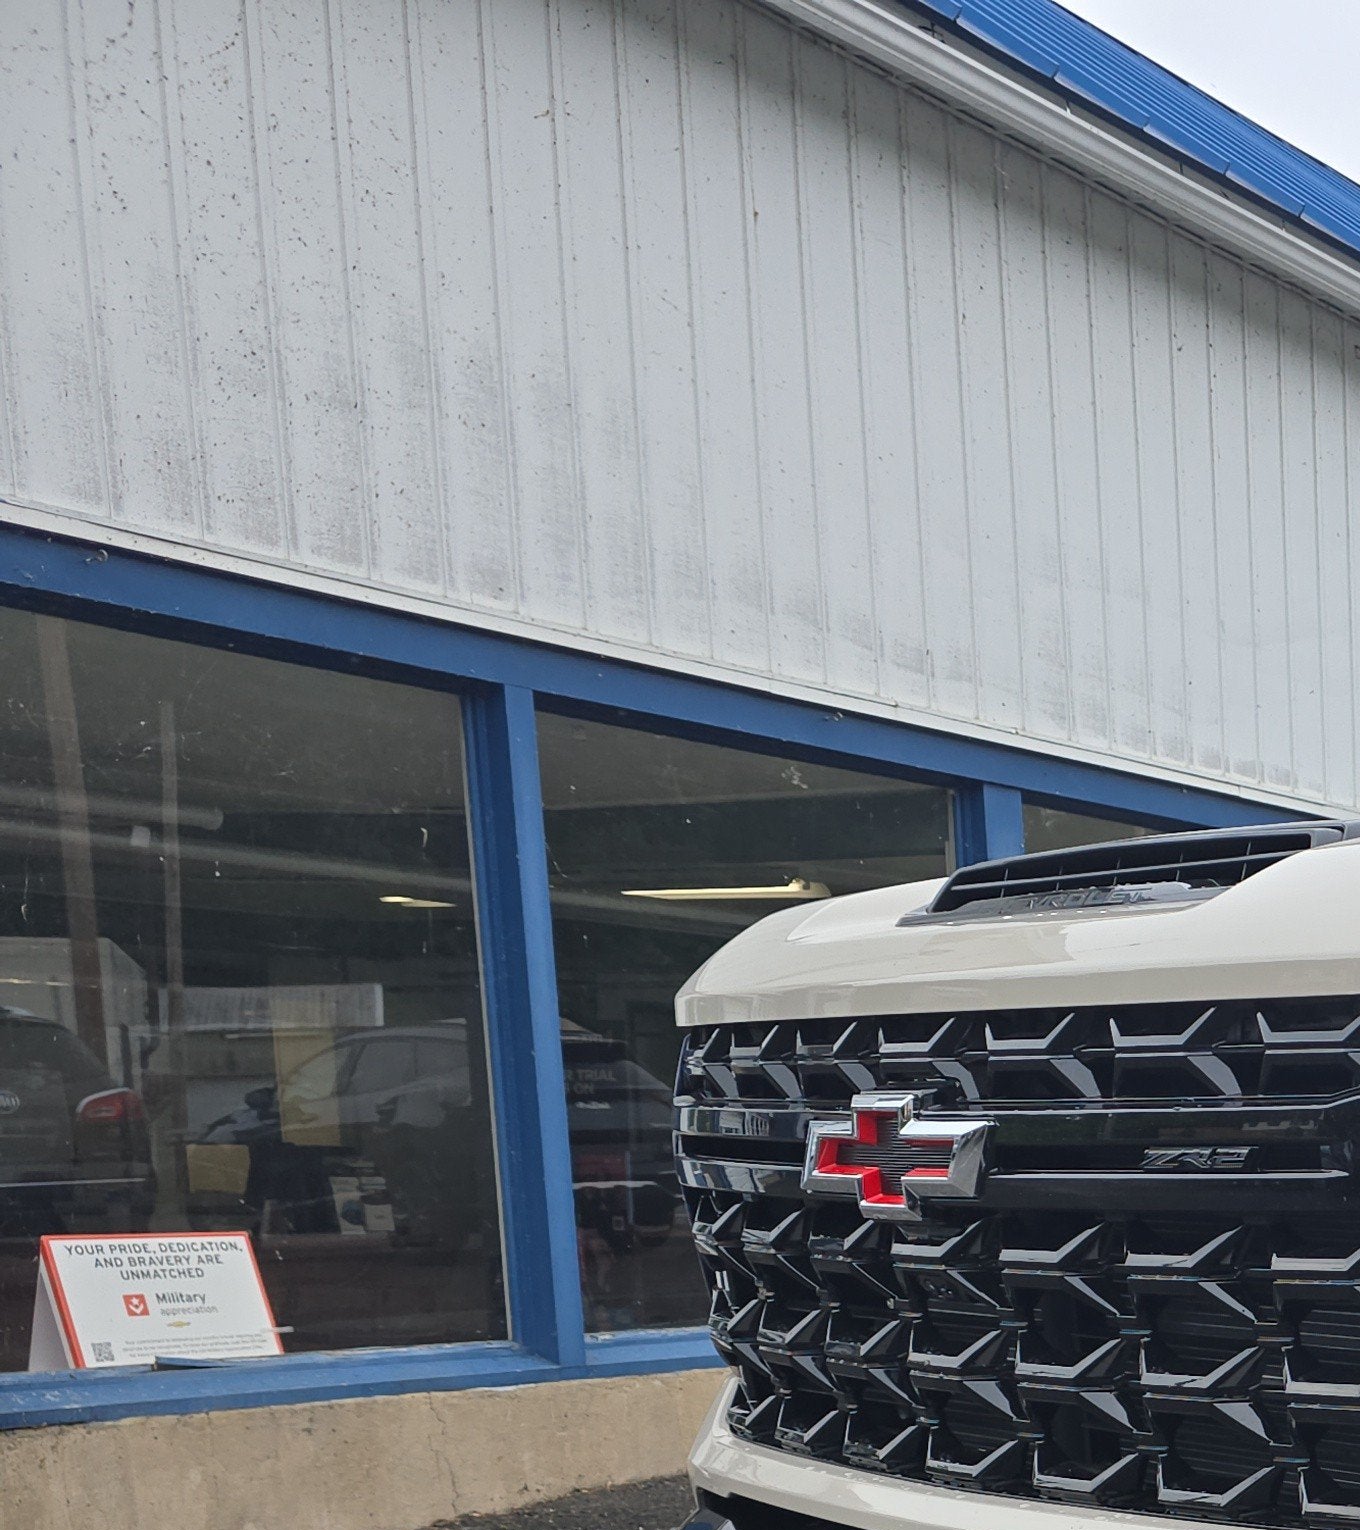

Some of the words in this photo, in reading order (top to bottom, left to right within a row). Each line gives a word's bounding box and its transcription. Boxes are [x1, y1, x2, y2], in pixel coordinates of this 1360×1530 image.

[1140, 1146, 1252, 1169] ZR2
[64, 1244, 104, 1256] YOUR
[109, 1242, 156, 1256] PRIDE,
[158, 1240, 244, 1254] DEDICATION,
[94, 1257, 124, 1269] AND
[127, 1255, 192, 1267] BRAVERY
[196, 1254, 224, 1265] ARE
[120, 1267, 205, 1281] UNMATCHED
[155, 1291, 207, 1305] Military
[160, 1305, 219, 1317] appreciation
